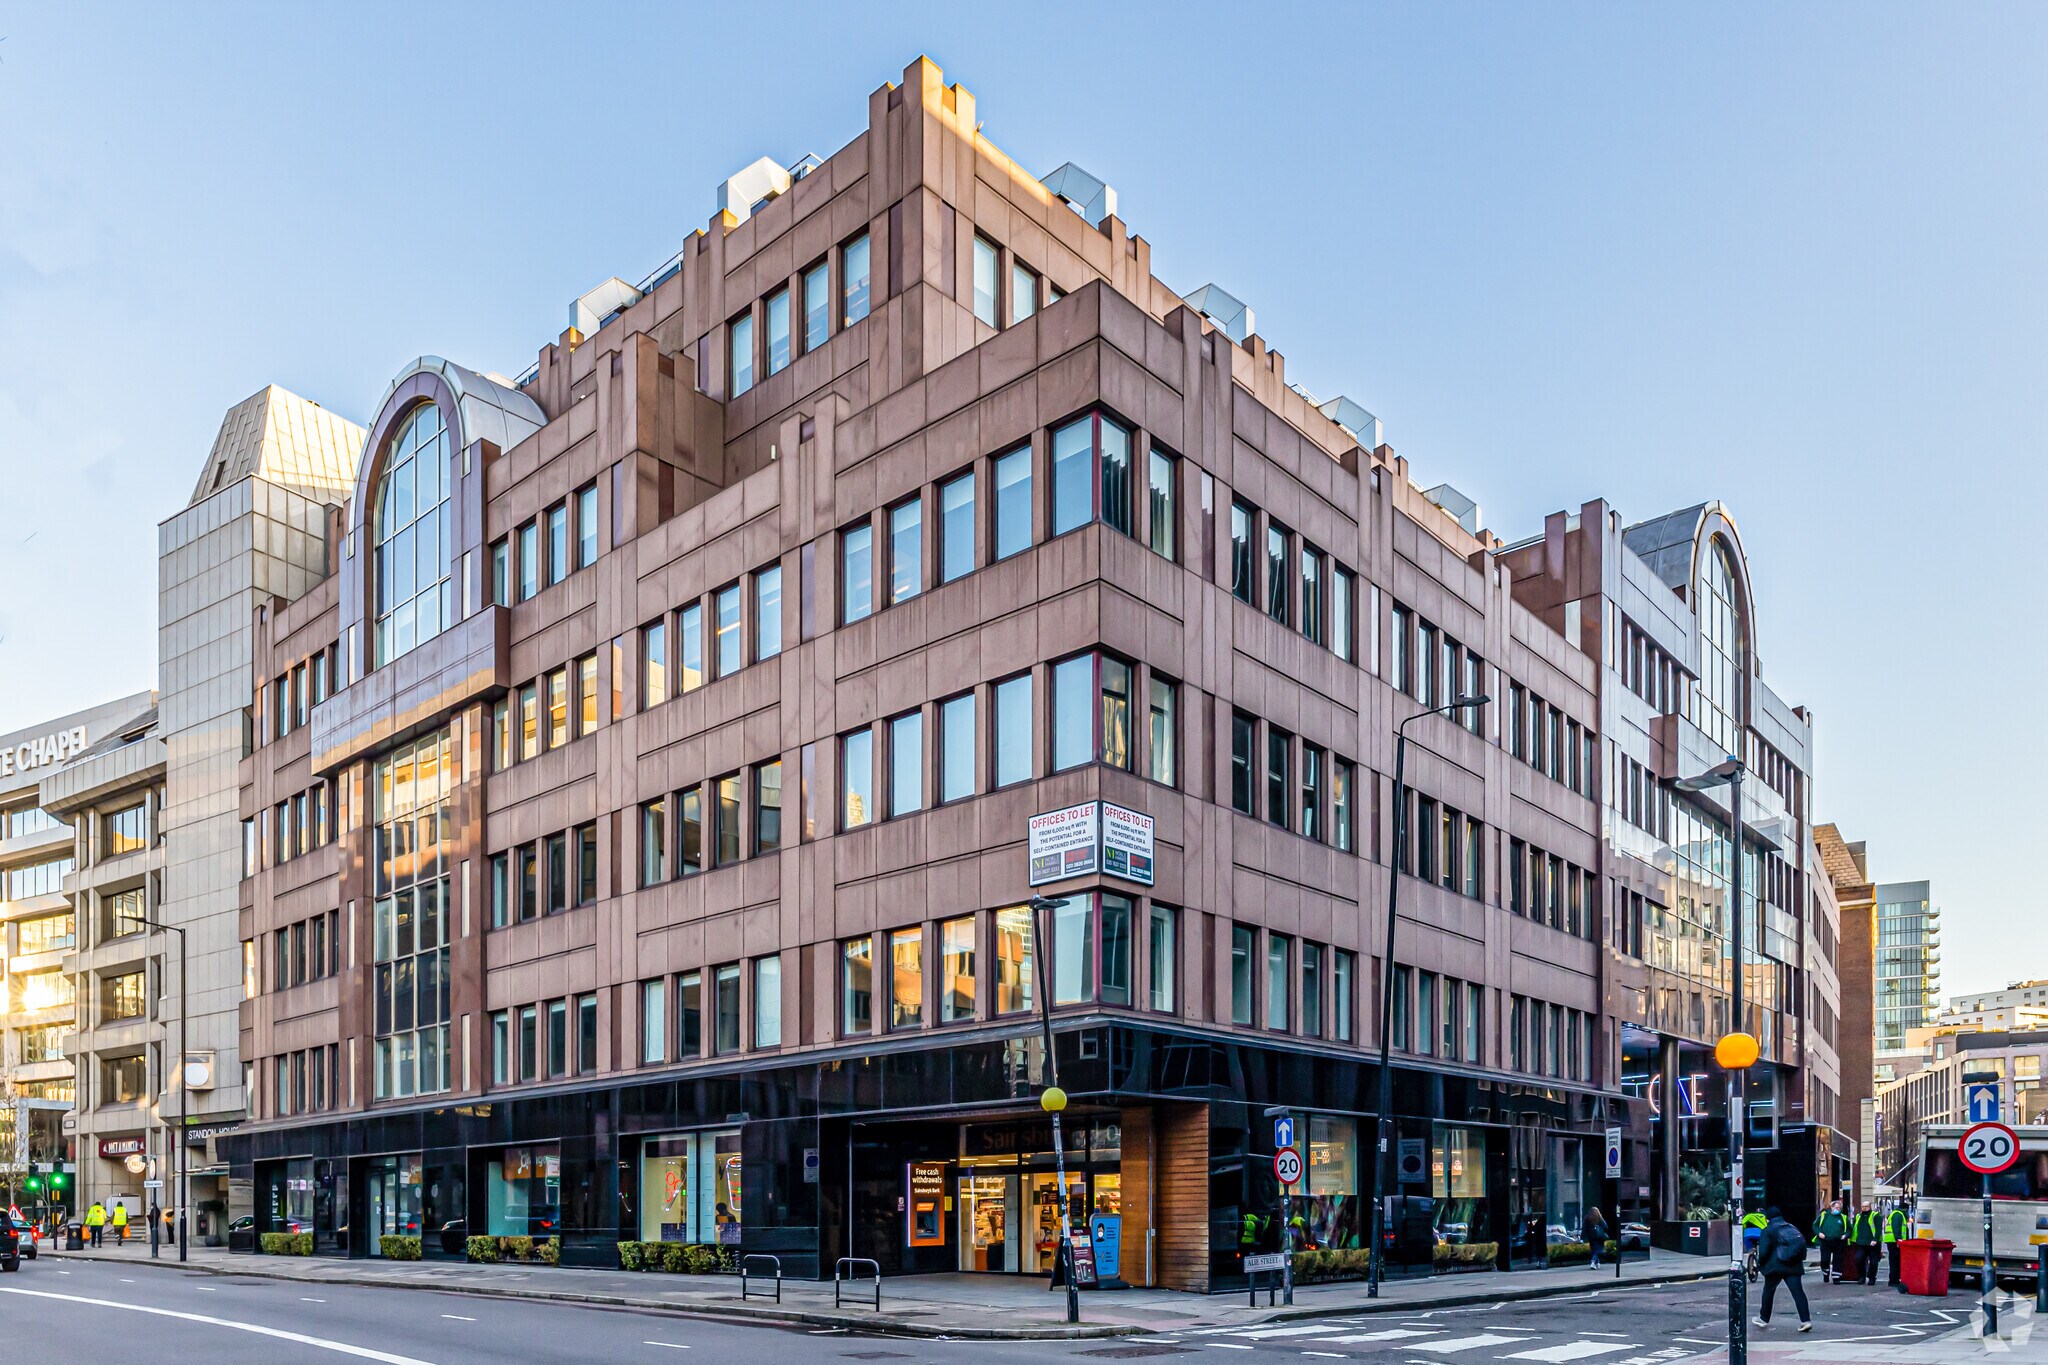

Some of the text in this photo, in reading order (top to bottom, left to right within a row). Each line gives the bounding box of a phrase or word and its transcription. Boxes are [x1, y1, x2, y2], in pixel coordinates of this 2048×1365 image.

[16, 725, 89, 771] CHAPEL
[1032, 805, 1095, 829] OFFICES TO LET
[1105, 806, 1152, 829] OFFICES TO LET
[1039, 829, 1052, 837] FROM
[1075, 820, 1088, 828] WITH
[1049, 832, 1073, 843] POTENTIAL
[1073, 829, 1083, 838] FOR
[1033, 835, 1094, 854] SELF-CONTAINED ENTRANCE
[188, 1128, 217, 1140] STANDON
[1968, 1136, 2010, 1159] 20
[915, 1167, 939, 1175] Free cash
[1278, 1158, 1299, 1174] 20
[912, 1176, 943, 1184] withdrawals
[1247, 1258, 1259, 1266] ALIE
[1260, 1256, 1279, 1265] STREET
